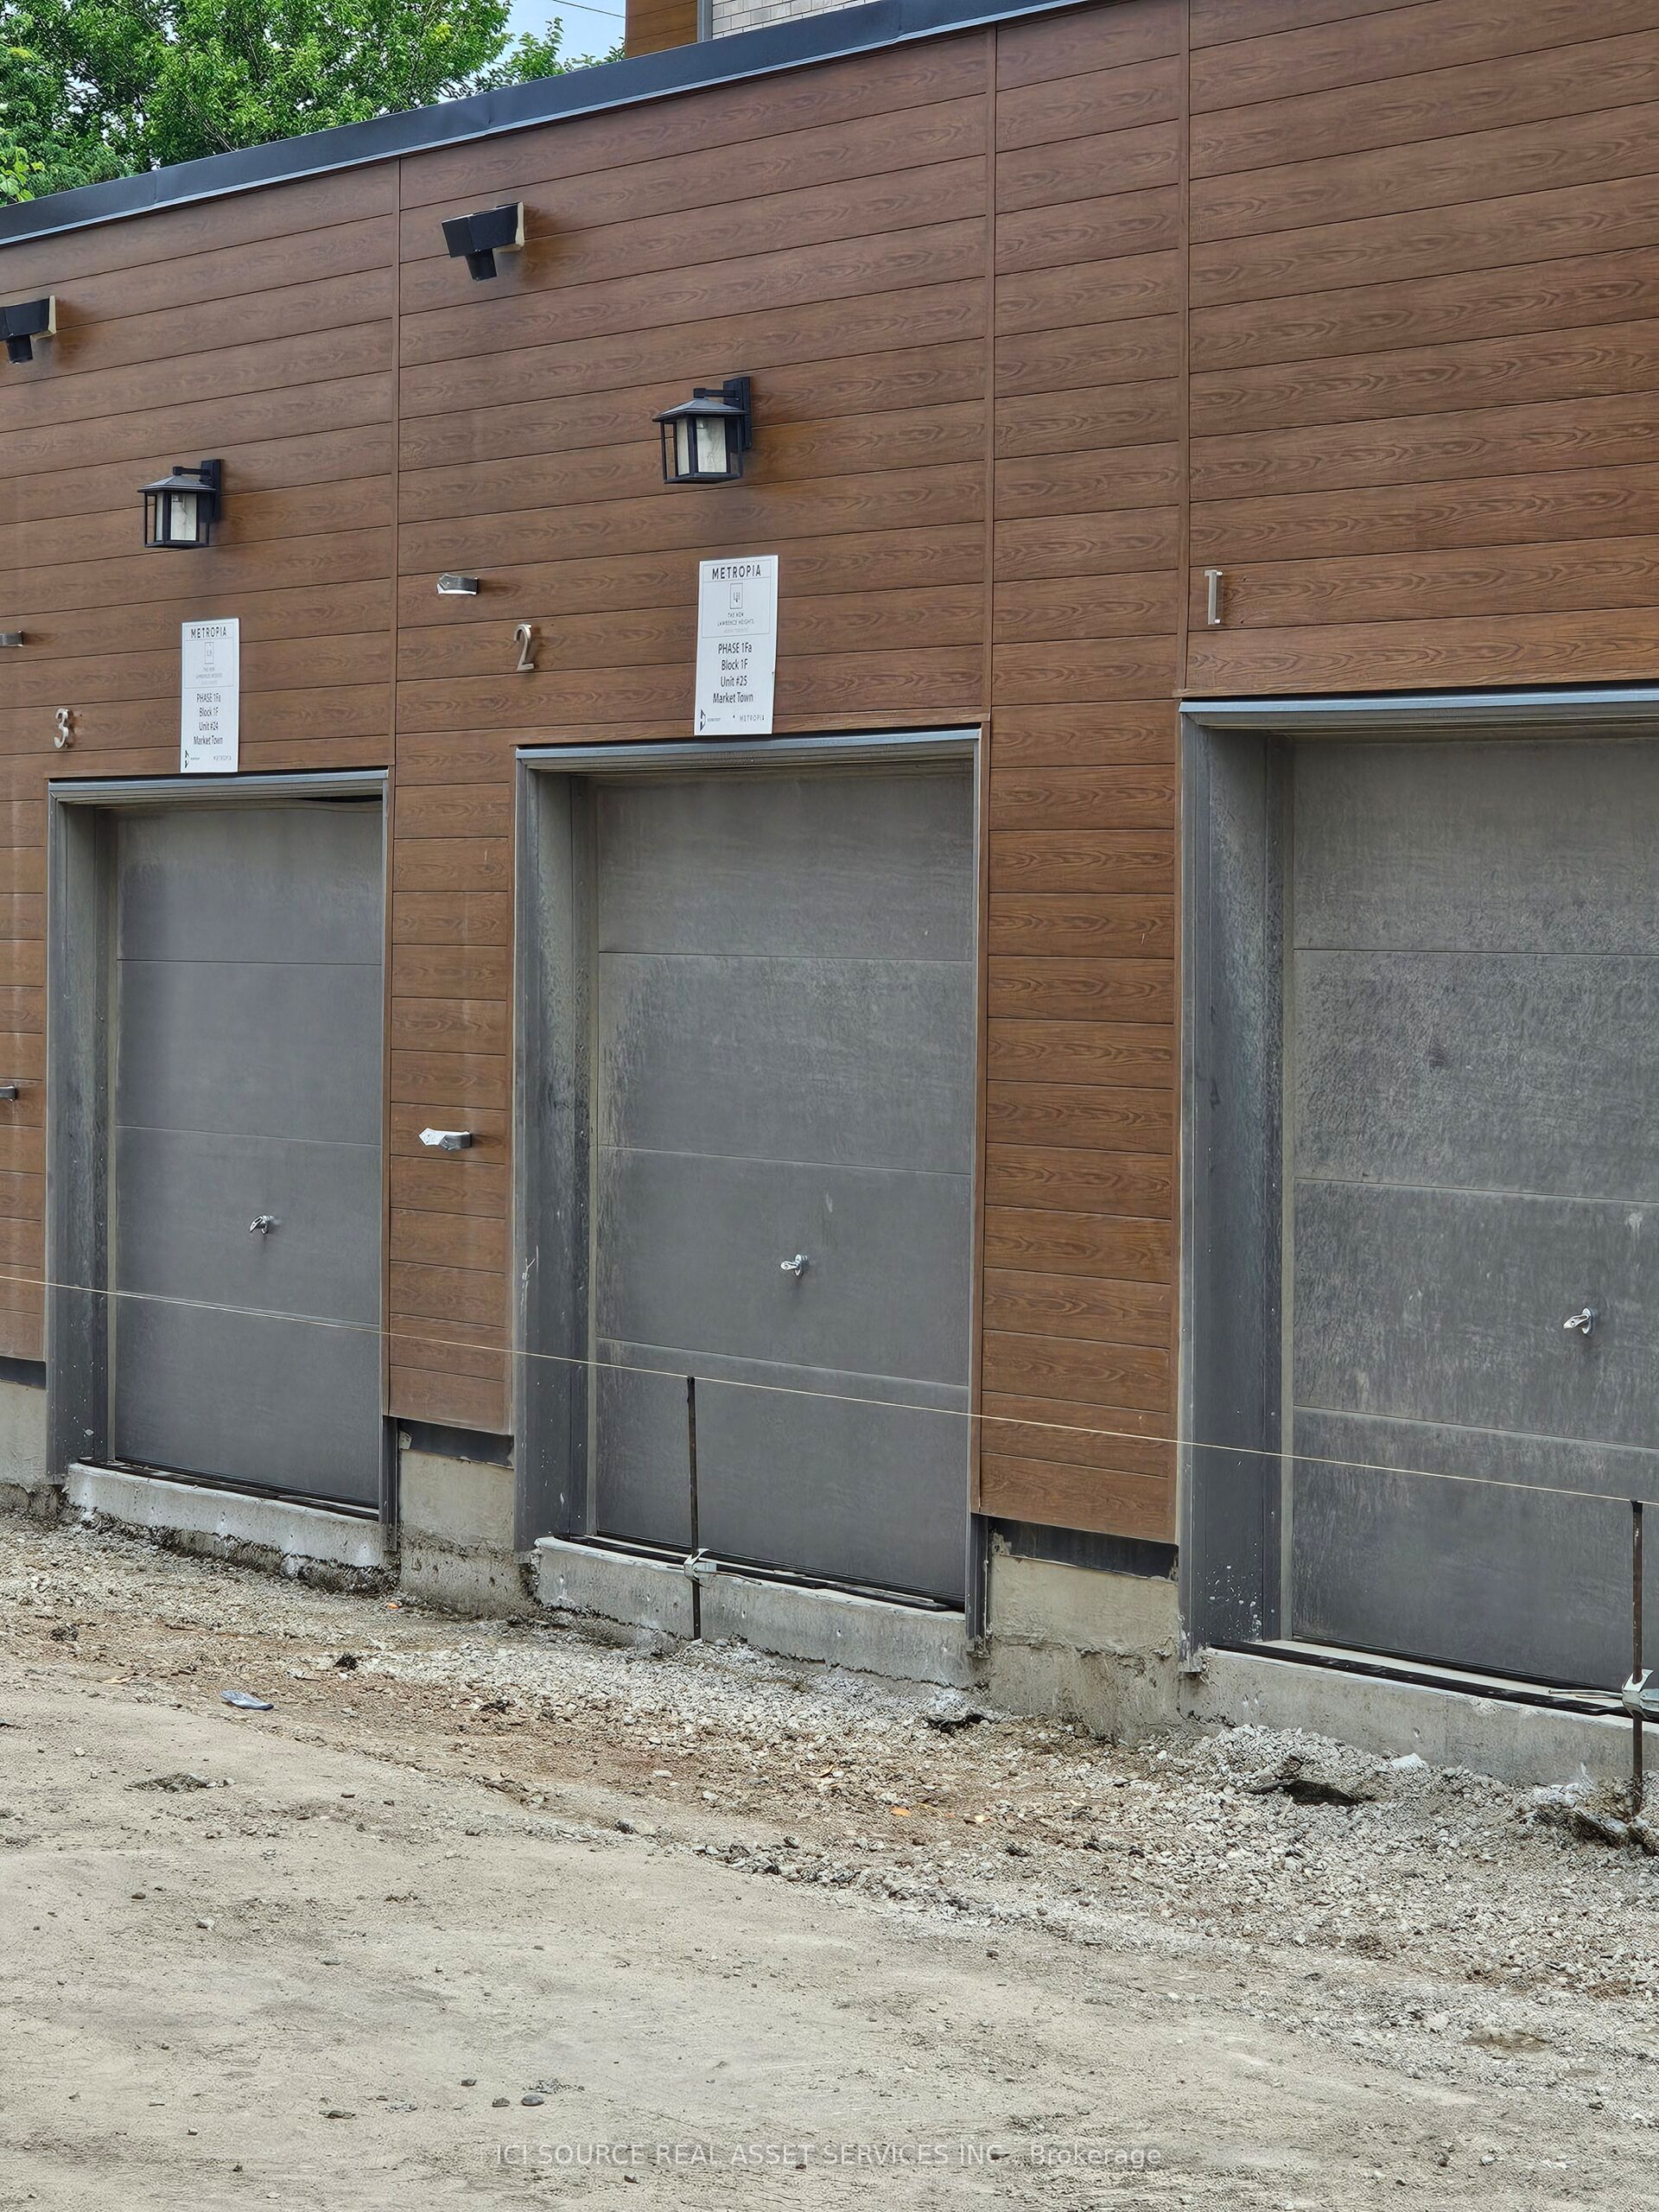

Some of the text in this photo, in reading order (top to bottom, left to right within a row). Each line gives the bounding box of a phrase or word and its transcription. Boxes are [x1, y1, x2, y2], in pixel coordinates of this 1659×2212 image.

[712, 564, 761, 580] METROPIA
[191, 626, 226, 639] METROPIA
[513, 624, 531, 671] 2
[718, 642, 753, 654] PHASE 1Fa
[721, 658, 748, 671] Block 1F
[721, 676, 734, 687] Unit
[196, 693, 213, 702] PHASE
[713, 691, 753, 703] Market Town
[199, 706, 213, 717] Block
[54, 708, 69, 749] 3
[199, 721, 209, 731] Unit
[194, 734, 223, 745] Market Town
